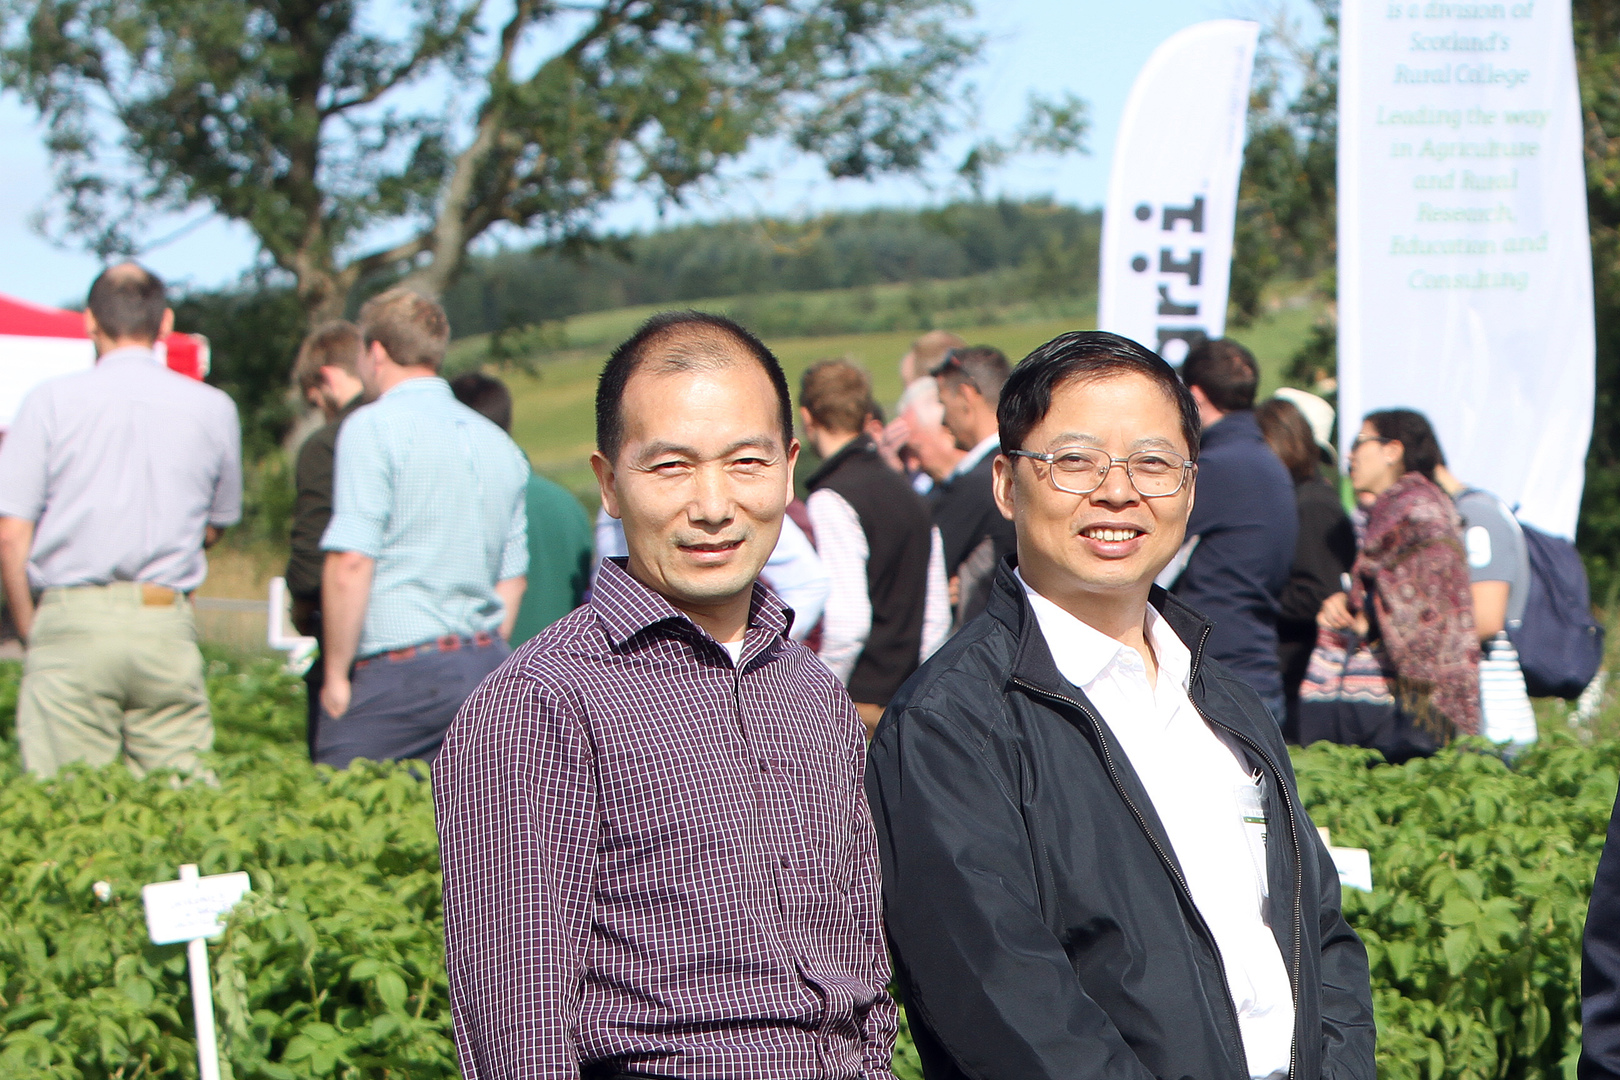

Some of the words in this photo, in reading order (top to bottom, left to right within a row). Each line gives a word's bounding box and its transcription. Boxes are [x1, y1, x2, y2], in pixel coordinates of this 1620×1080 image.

[1385, 0, 1403, 19] is
[1405, 4, 1421, 19] a
[1424, 0, 1505, 19] division
[1511, 0, 1535, 19] of
[1409, 31, 1511, 52] Scotland's
[1393, 63, 1451, 85] Rural
[1455, 63, 1531, 88] College
[1375, 105, 1462, 130] Leading
[1467, 104, 1497, 125] the
[1503, 109, 1551, 130] way
[1390, 139, 1412, 158] in
[1419, 137, 1541, 161] Agriculture
[1413, 169, 1455, 190] and
[1460, 169, 1518, 190] Rural
[1389, 235, 1496, 256] Education
[1502, 231, 1549, 252] and
[1131, 195, 1208, 374] grii
[1408, 268, 1529, 292] Consulting
